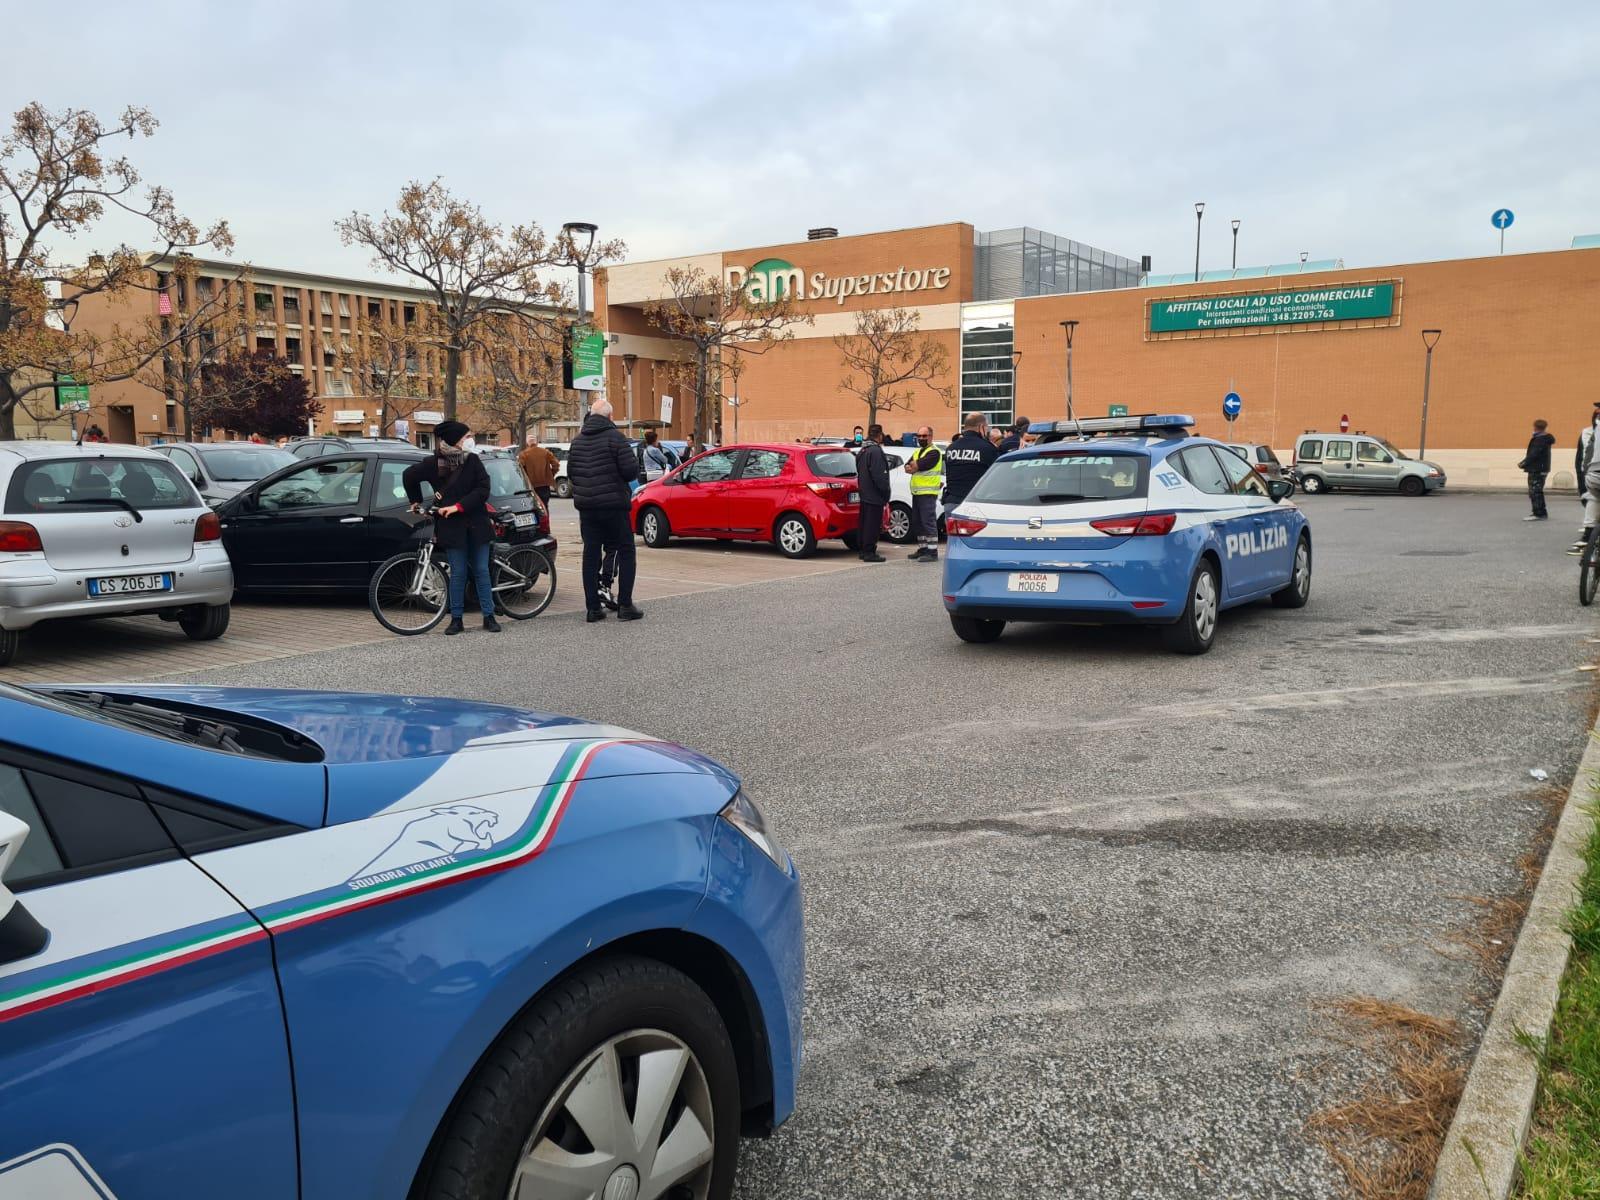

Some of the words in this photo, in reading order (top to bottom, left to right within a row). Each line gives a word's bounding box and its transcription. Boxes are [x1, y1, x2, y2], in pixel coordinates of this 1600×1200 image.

[808, 265, 950, 304] Superstore
[1166, 301, 1212, 313] AFFITTASI
[1214, 298, 1249, 310] LOCALI
[1252, 296, 1267, 307] AD
[1270, 295, 1291, 305] USO
[1294, 288, 1375, 303] COMMERCIALE
[1198, 318, 1211, 326] Per
[1214, 315, 1270, 325] informazioni:
[1273, 309, 1335, 321] 348.2209.763
[1206, 309, 1245, 318] Interessanti
[1246, 306, 1281, 315] condizioni
[1283, 303, 1326, 313] economiche
[946, 450, 981, 462] POLIZIA
[1011, 456, 1114, 469] POLIZIA
[1156, 471, 1182, 488] 113
[1225, 525, 1288, 560] POLIZIA
[348, 869, 407, 891] SQUADRA
[405, 854, 459, 875] VOLANTE
